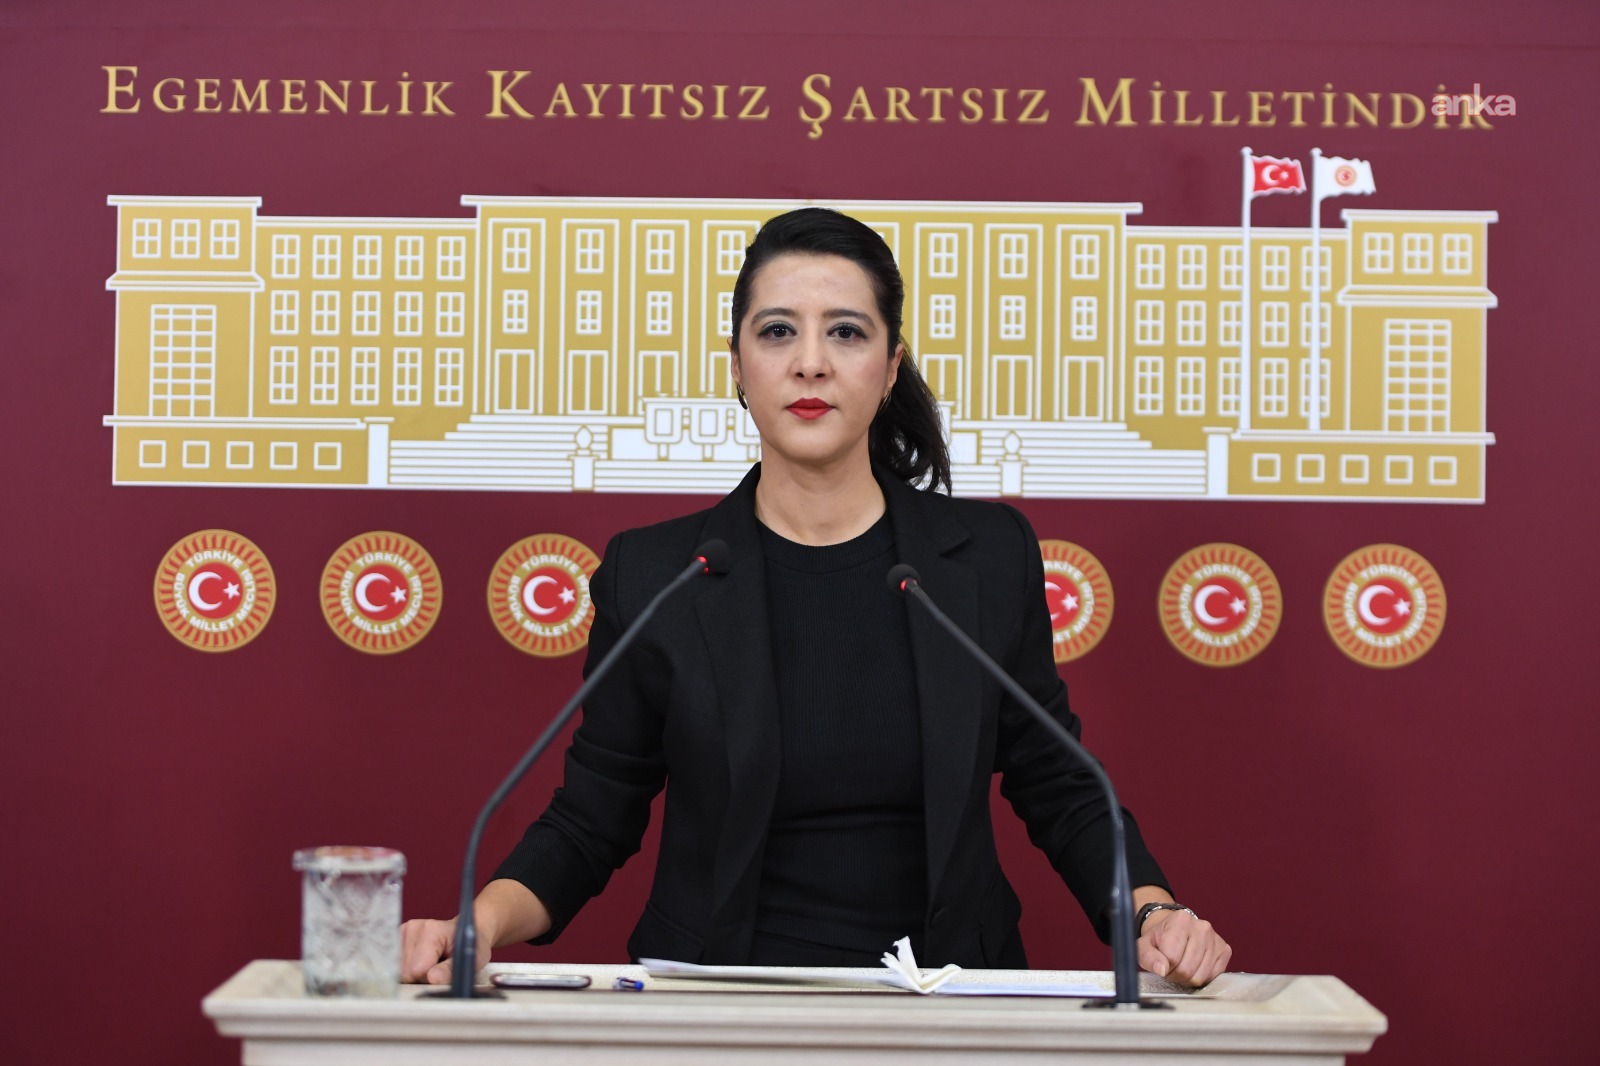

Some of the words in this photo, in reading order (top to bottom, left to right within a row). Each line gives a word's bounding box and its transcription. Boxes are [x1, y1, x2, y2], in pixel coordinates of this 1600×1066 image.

[100, 65, 455, 116] EGEMENLİK
[485, 69, 770, 119] KAYITSIZ
[800, 73, 1050, 140] ŞARTSIZ
